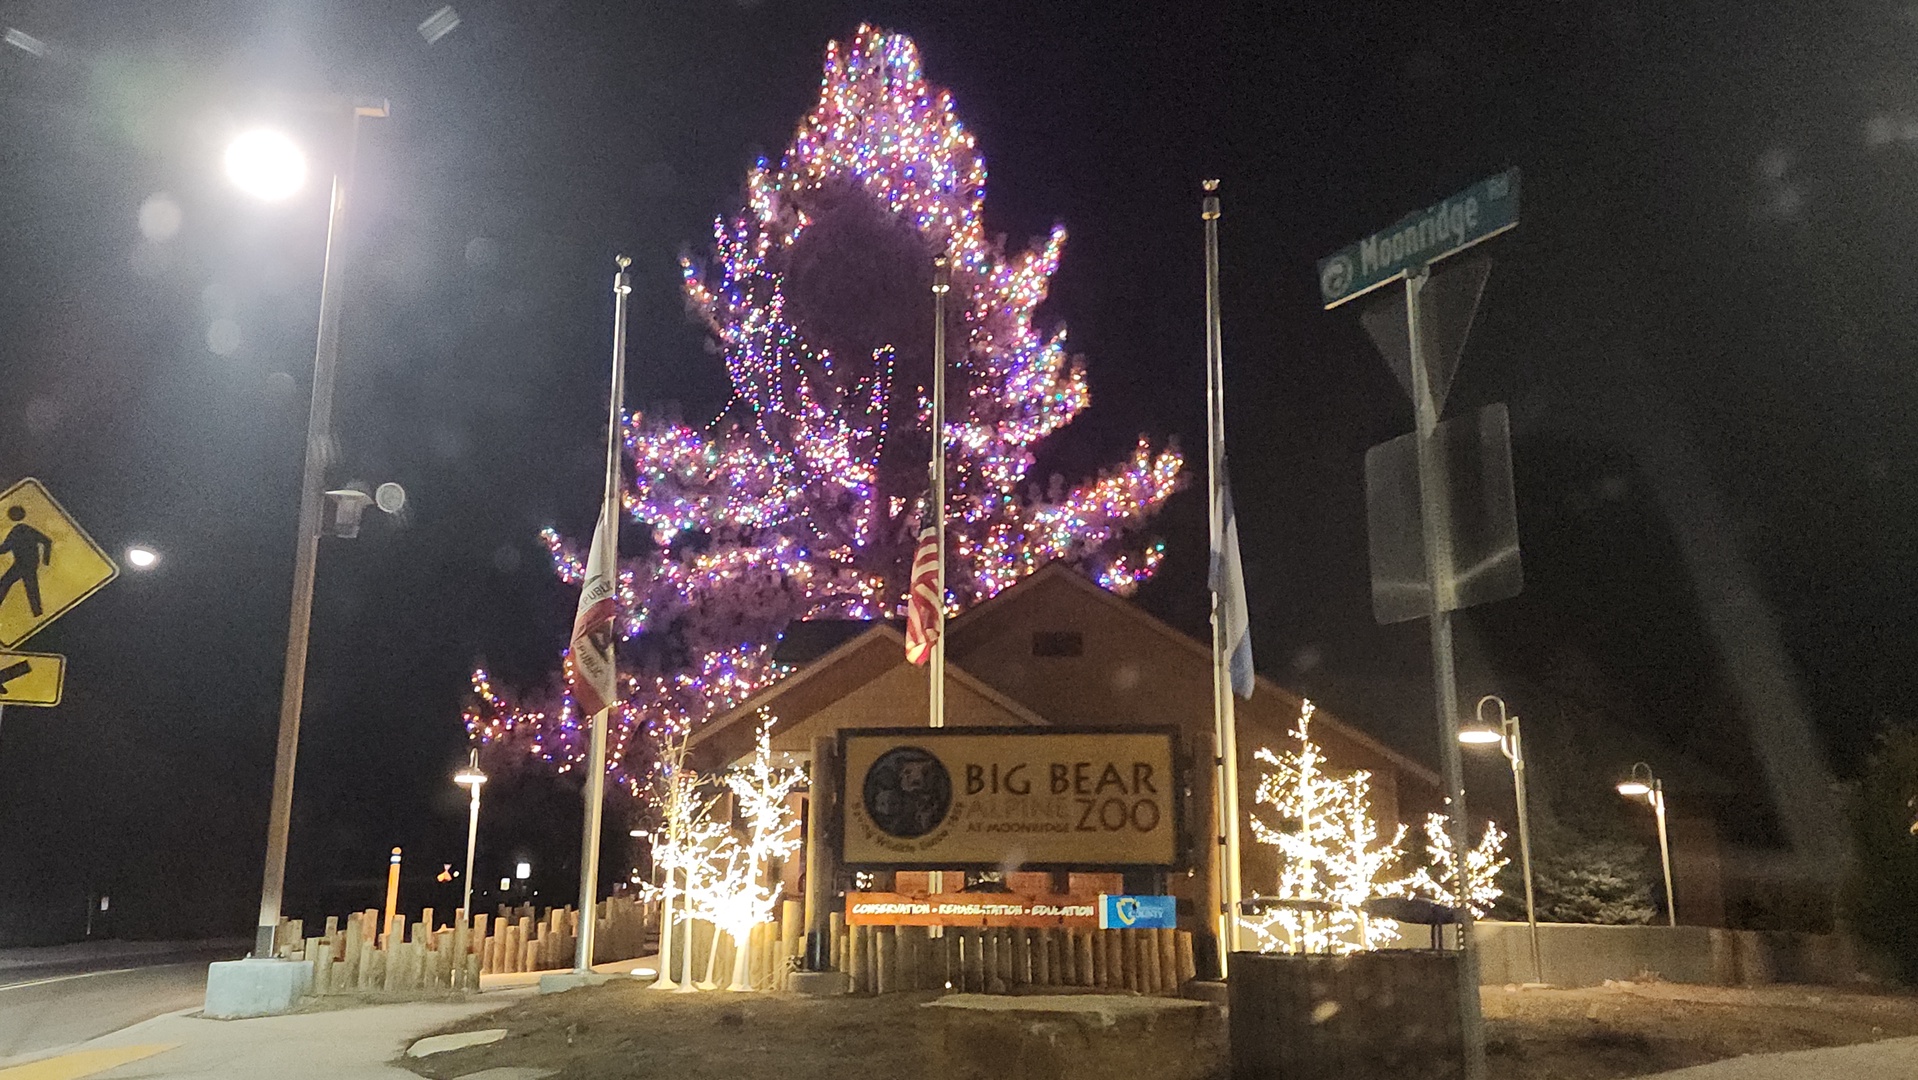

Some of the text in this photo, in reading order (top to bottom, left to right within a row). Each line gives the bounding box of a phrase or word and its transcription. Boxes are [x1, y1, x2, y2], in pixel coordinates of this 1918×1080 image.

[1360, 197, 1478, 276] Moonridge
[965, 761, 1157, 795] BIG BEAR
[1074, 797, 1161, 832] ZOO
[851, 903, 930, 916] CONSERVATION
[1031, 905, 1094, 917] EDUCATION
